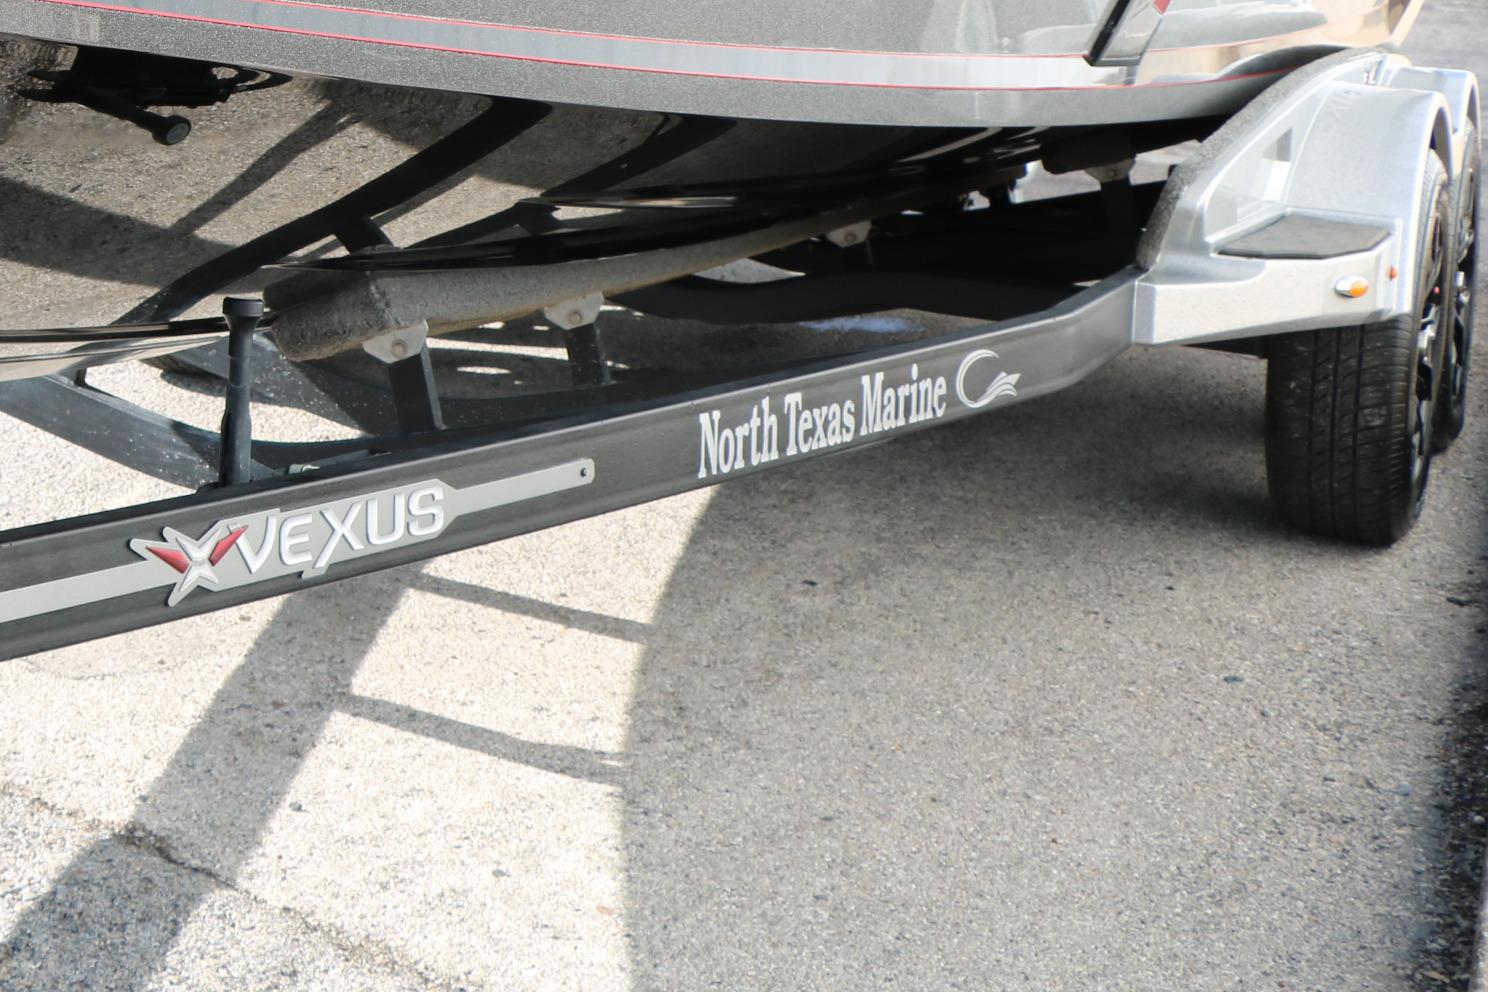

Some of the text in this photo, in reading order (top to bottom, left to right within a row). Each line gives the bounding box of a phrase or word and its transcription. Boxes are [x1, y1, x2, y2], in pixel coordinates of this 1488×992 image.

[697, 364, 947, 479] North Texas Marine
[227, 486, 445, 575] VEXUS
